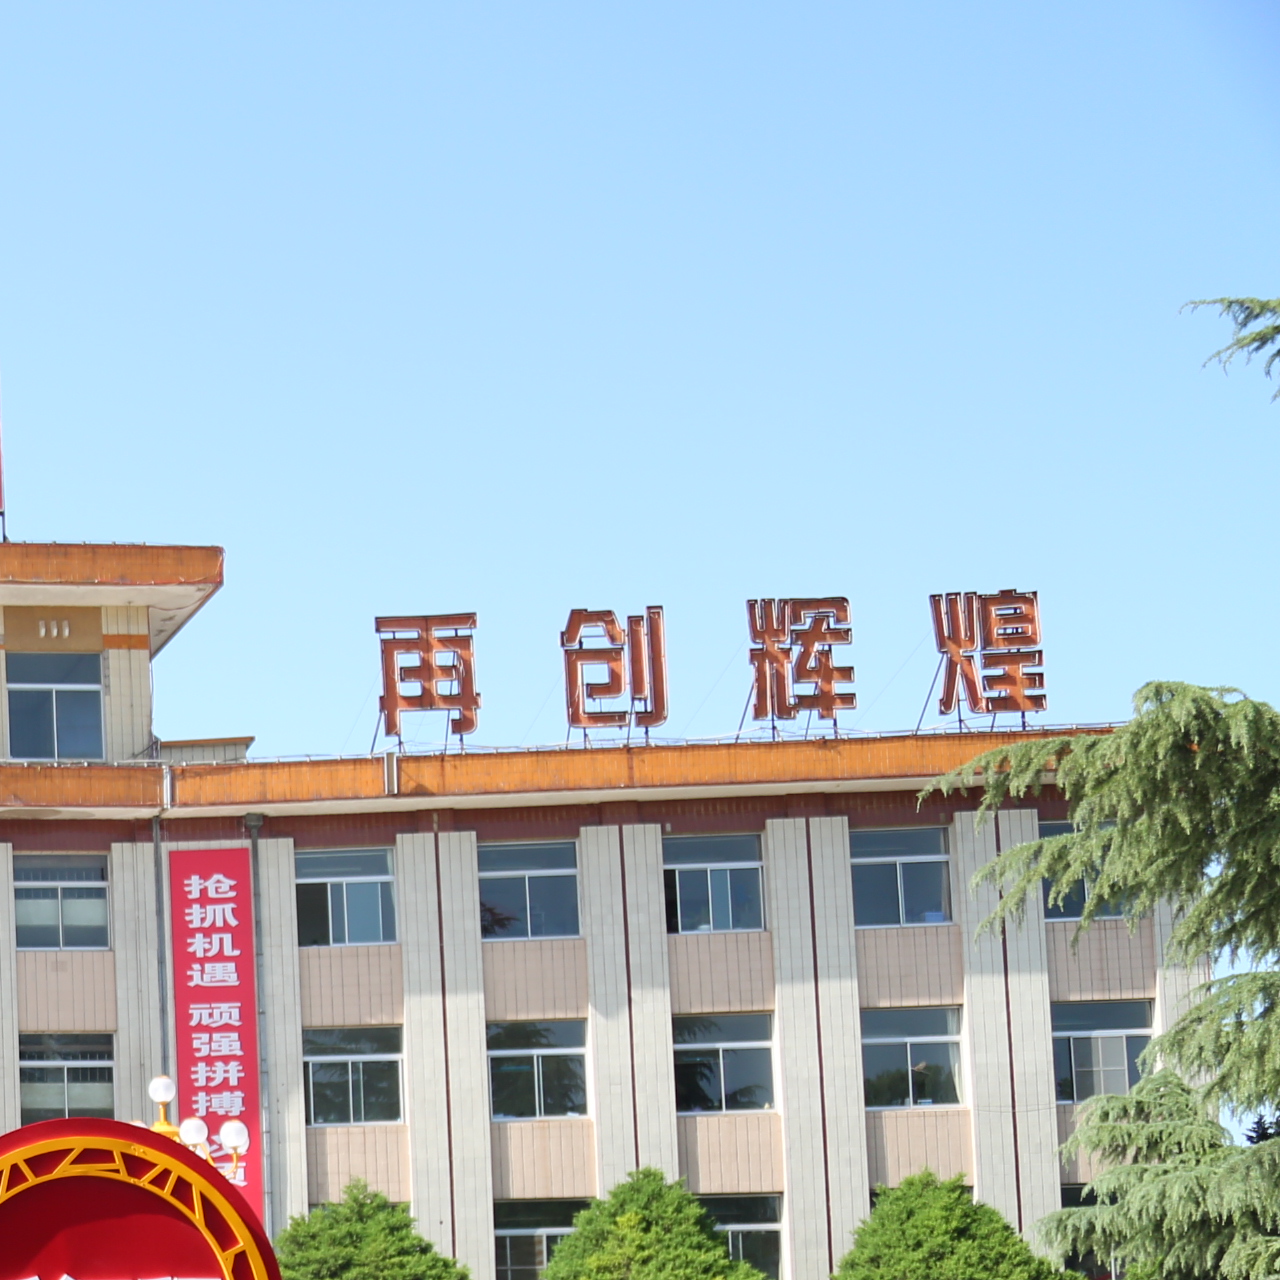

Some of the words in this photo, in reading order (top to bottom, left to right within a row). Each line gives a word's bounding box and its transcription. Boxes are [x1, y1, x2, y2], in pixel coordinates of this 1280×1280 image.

[374, 589, 1047, 735] 再创辉煌
[184, 873, 241, 988] 抢抓机遇
[189, 1002, 245, 1117] 顽强拼搏
